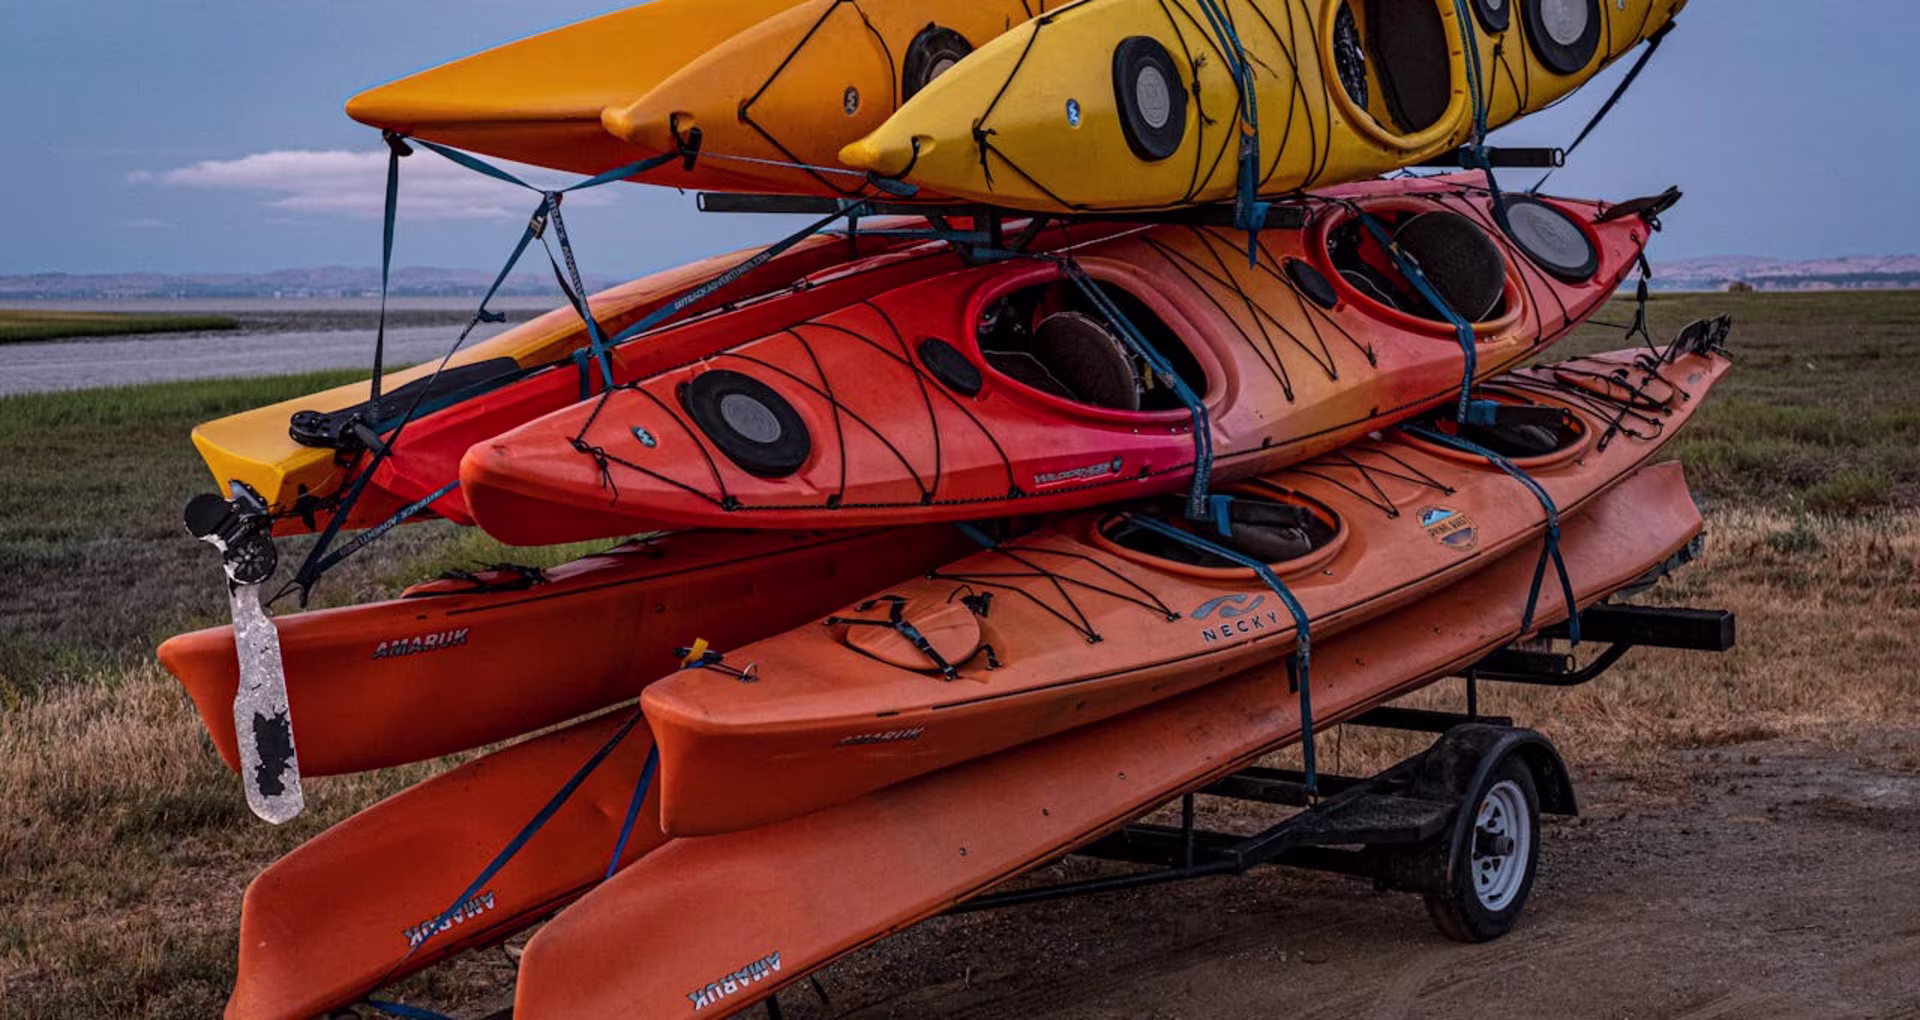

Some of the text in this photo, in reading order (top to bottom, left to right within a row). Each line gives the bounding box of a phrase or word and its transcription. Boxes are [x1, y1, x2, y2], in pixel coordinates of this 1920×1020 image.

[1202, 611, 1277, 642] NECKY
[372, 628, 469, 660] AMARUK
[686, 950, 781, 1011] AMARUK
